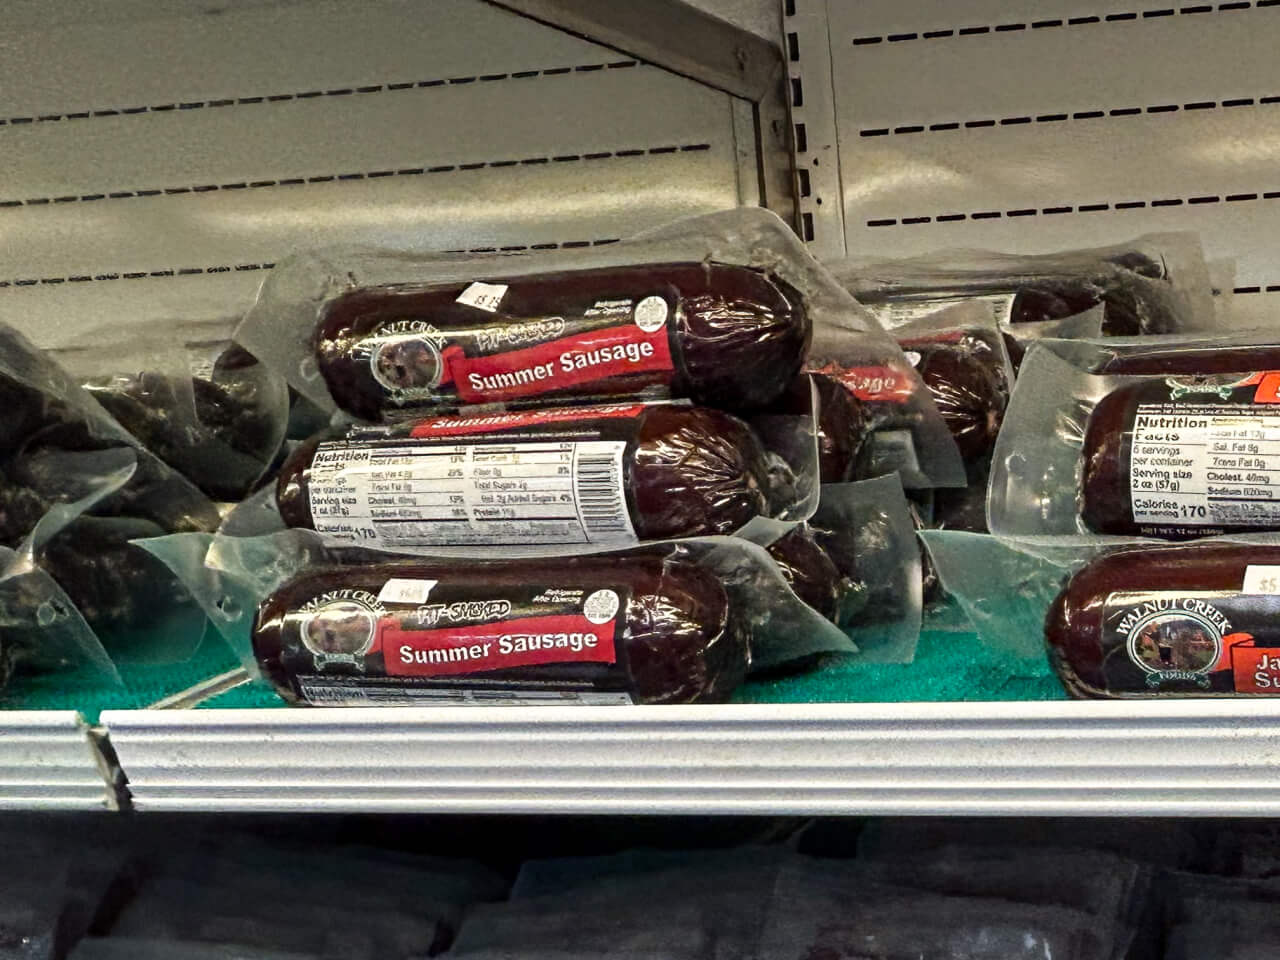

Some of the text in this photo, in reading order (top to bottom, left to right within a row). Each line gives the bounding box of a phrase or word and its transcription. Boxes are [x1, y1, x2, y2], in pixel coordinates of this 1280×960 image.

[468, 339, 655, 392] Summer Sausage
[431, 411, 523, 430] Summer
[1137, 416, 1208, 429] Nutrition
[1181, 505, 1208, 519] 170
[1116, 598, 1233, 636] WALNUT CREEK
[400, 630, 599, 665] Summer Sausage
